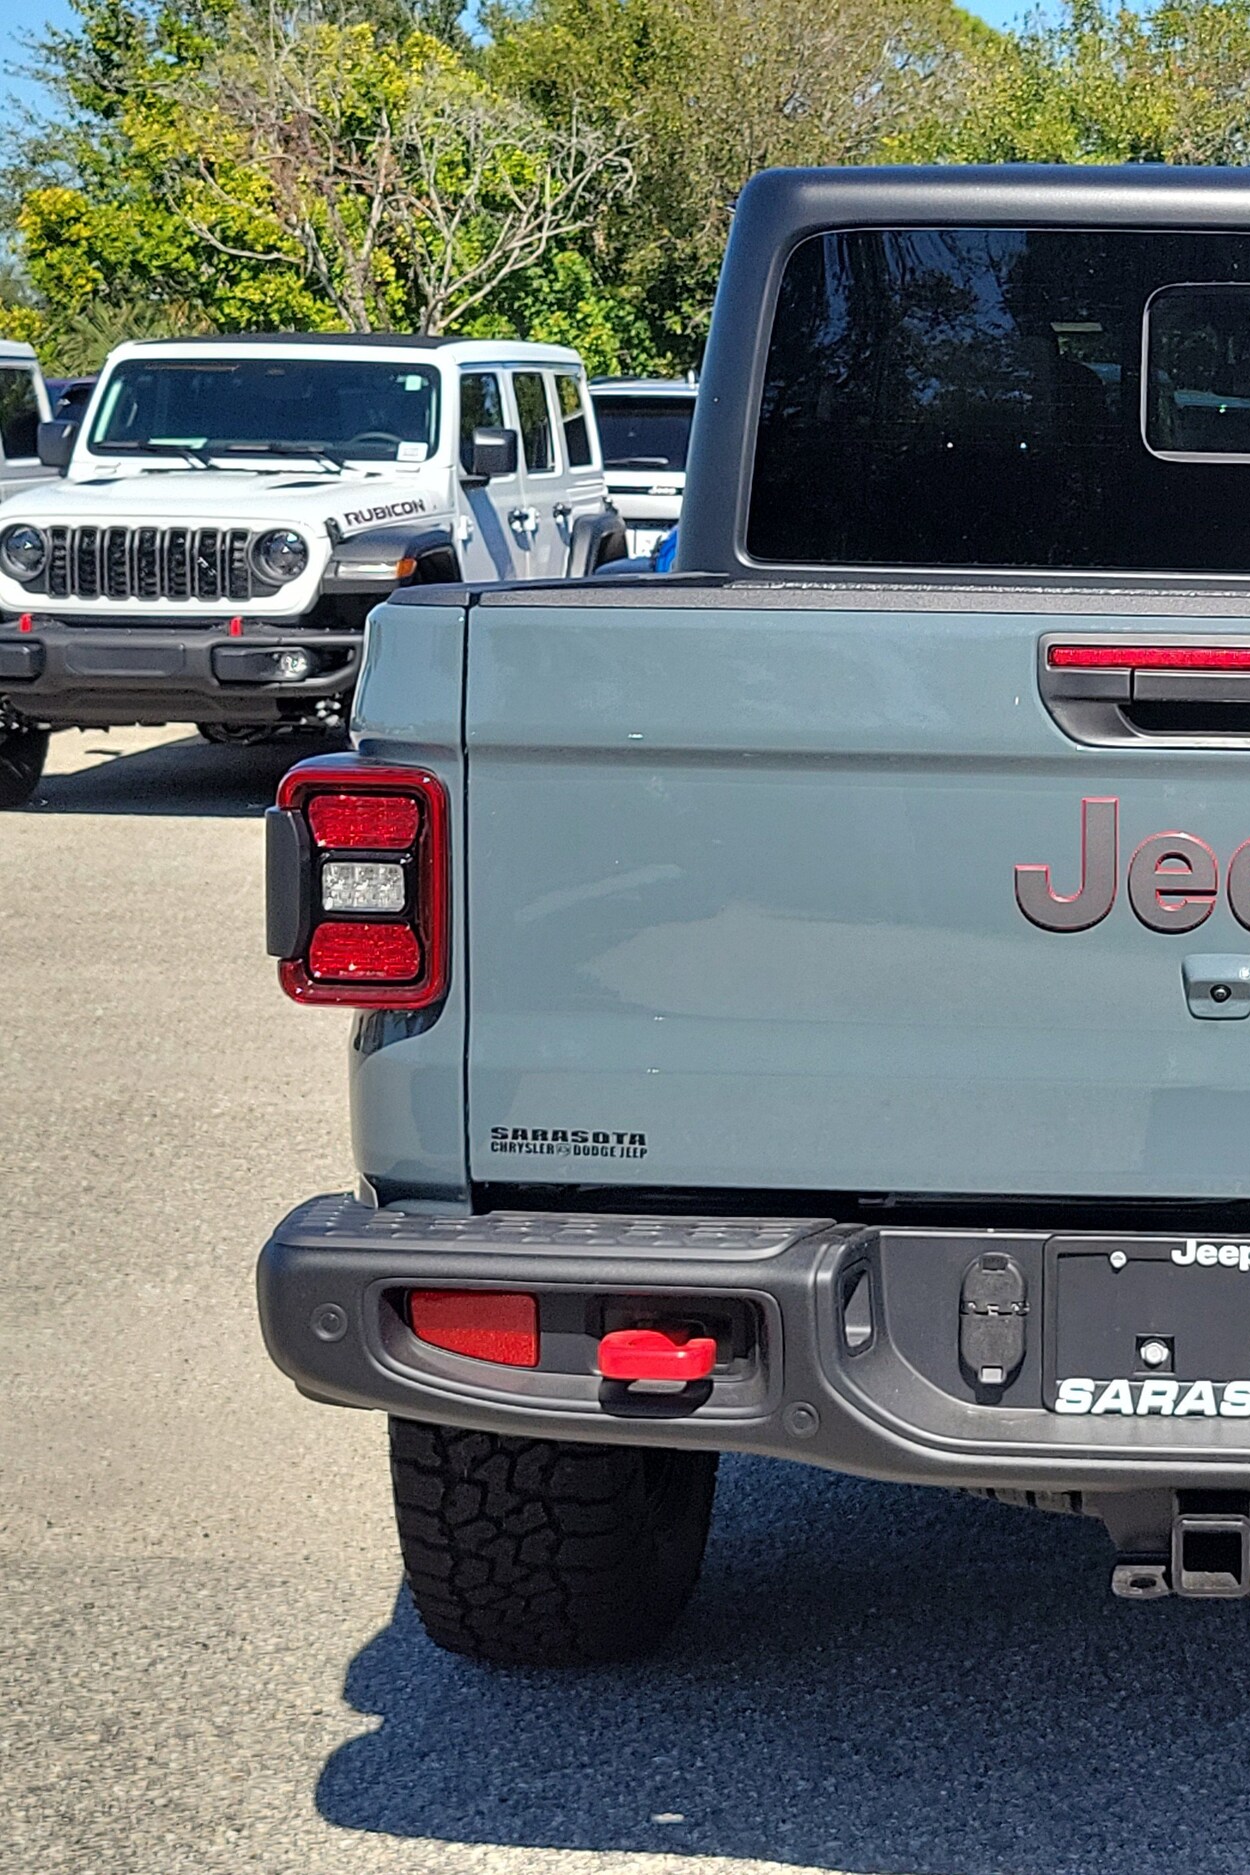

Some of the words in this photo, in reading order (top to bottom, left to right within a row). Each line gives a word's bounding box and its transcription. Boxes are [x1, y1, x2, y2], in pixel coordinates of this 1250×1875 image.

[342, 497, 427, 526] RUBICON
[490, 1126, 647, 1146] SARASOTA
[490, 1141, 555, 1156] CHRYSLER
[573, 1144, 617, 1157] DODGE
[619, 1146, 648, 1159] JEEP
